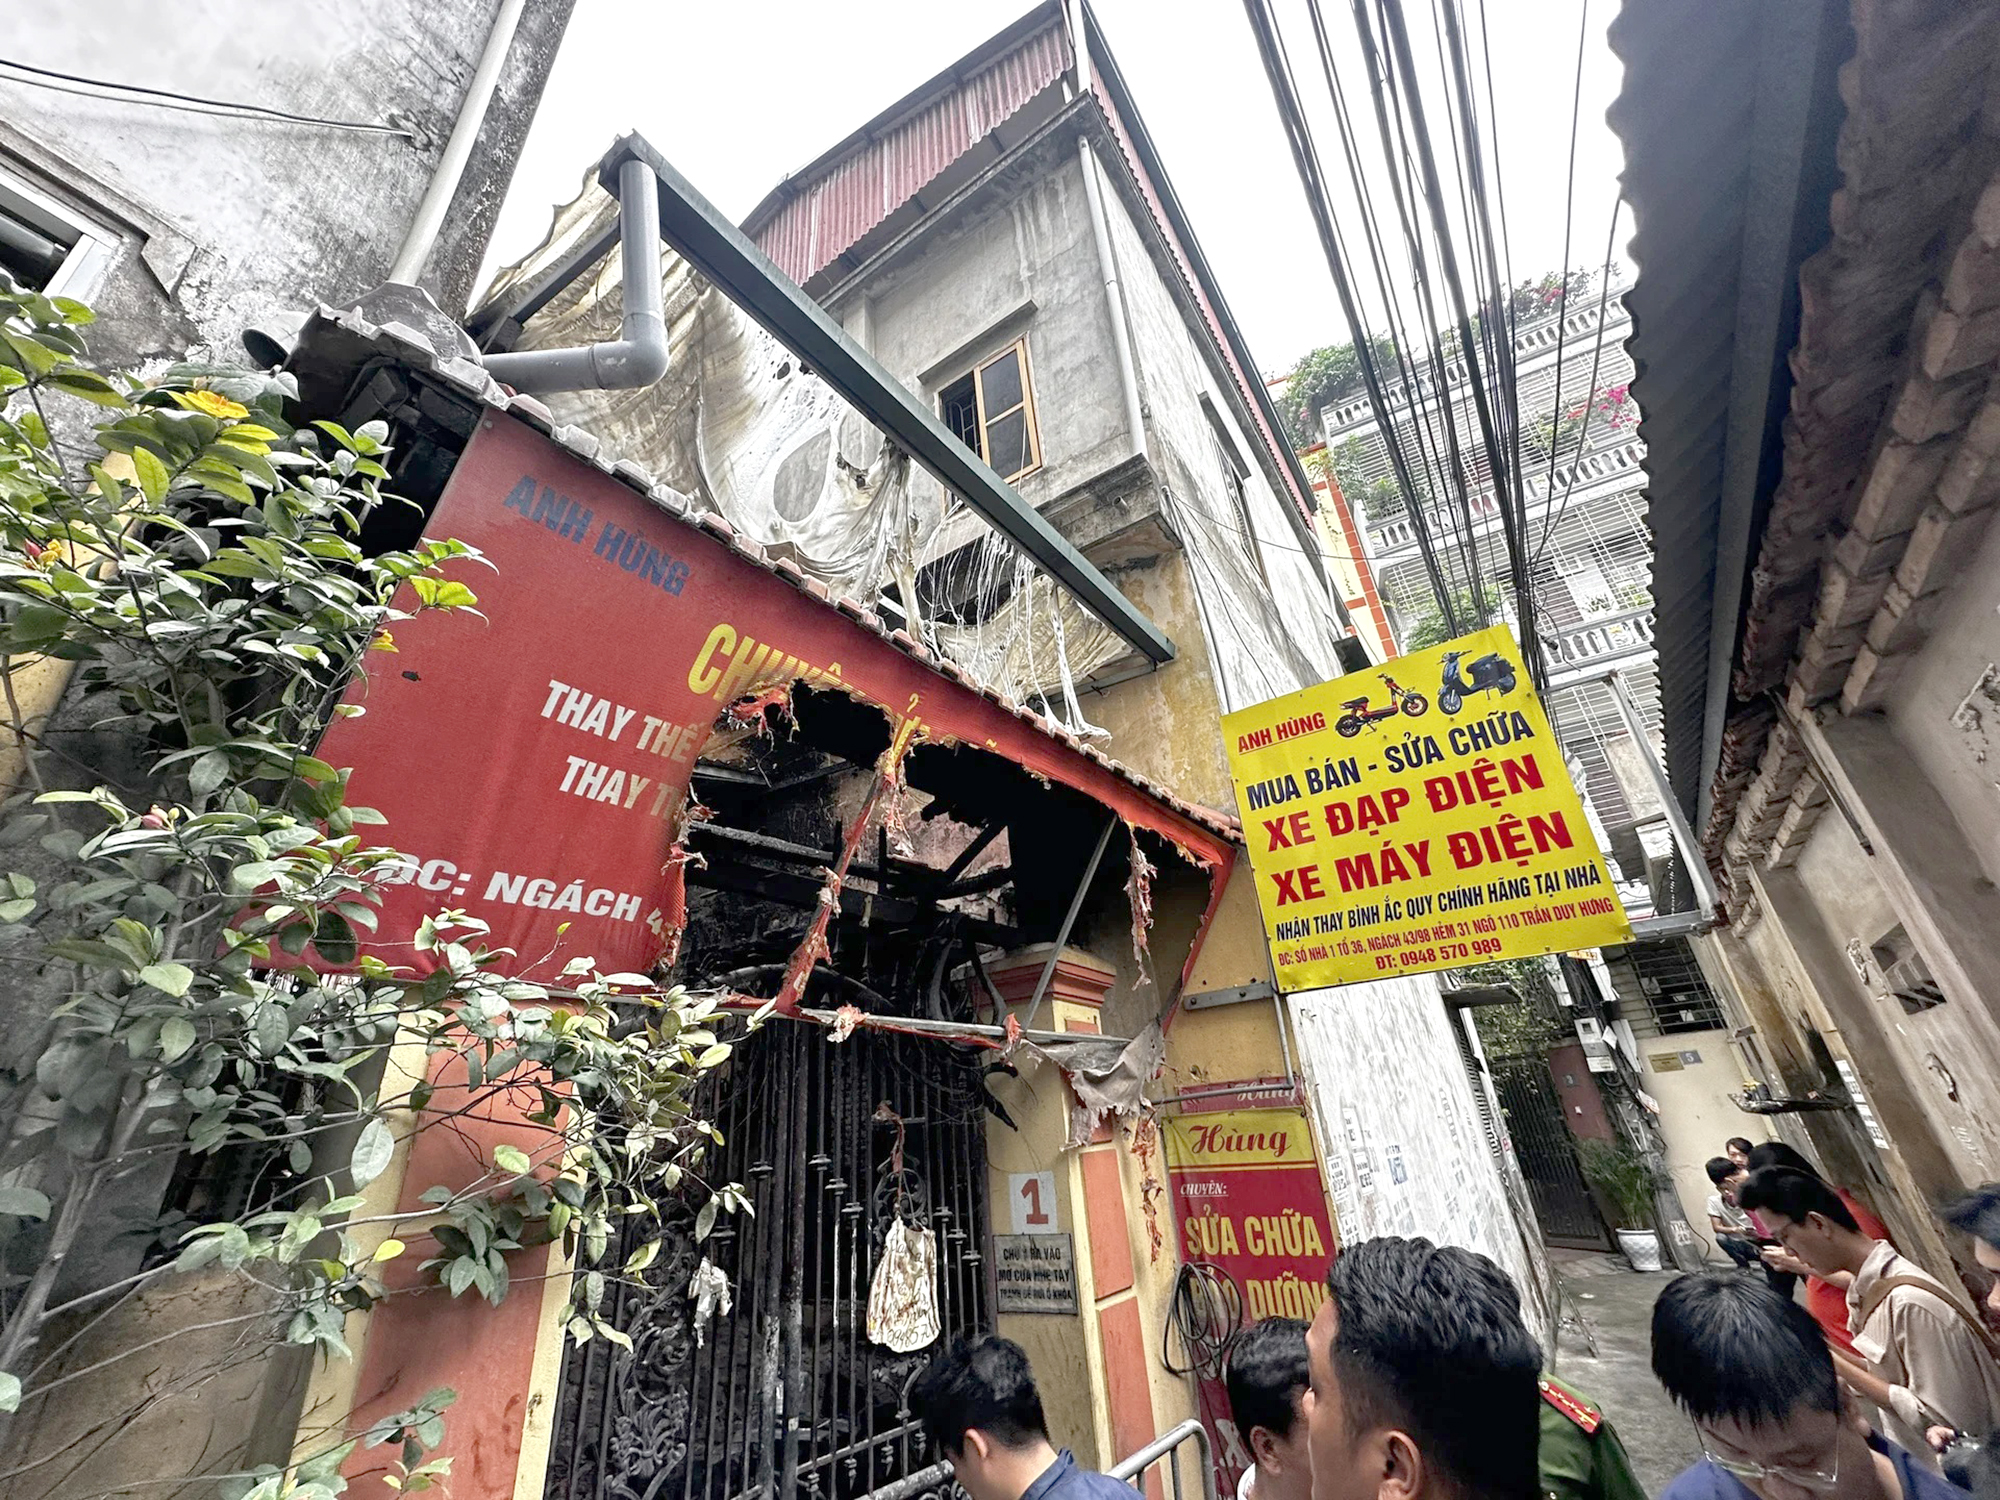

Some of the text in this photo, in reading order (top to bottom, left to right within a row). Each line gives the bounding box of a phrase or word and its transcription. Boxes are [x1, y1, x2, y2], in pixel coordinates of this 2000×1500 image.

[504, 475, 691, 597] ANH HÙNG
[541, 679, 637, 742] THAY
[1238, 712, 1327, 752] ANH HÙNG
[559, 755, 651, 809] THAY
[1246, 710, 1535, 811] MUA BÁN - SỬA CHỮA
[1263, 753, 1545, 852] XE ĐẠP ĐIỆN
[1271, 811, 1574, 907] XE MÁY ĐIỆN
[483, 871, 642, 922] NGÁCH
[1276, 860, 1602, 942] NHẬN THAY BÌNH ẮC QUY CHÍNH HÃNG TẠI NHÀ
[1278, 952, 1294, 967] ĐC:
[1295, 942, 1308, 963] SỐ
[1308, 945, 1329, 961] NHÀ
[1329, 945, 1336, 957] 1
[1350, 940, 1367, 954] 36,
[1367, 933, 1401, 951] NGÁCH
[1402, 928, 1431, 946] 43/98
[1457, 921, 1472, 937] 31
[1473, 914, 1496, 934] NGÕ
[1500, 915, 1520, 930] 110
[1520, 904, 1552, 927] TRẦN
[1553, 903, 1577, 921] DUY
[1375, 937, 1502, 970] ĐT: 0948 570 989
[1188, 1124, 1292, 1157] Hùng
[1021, 1179, 1048, 1224] 1
[1180, 1179, 1228, 1195] CHUYÊN:
[1185, 1204, 1240, 1257] SỬA
[1244, 1208, 1325, 1257] CHỮA
[1054, 1269, 1070, 1282] TAY
